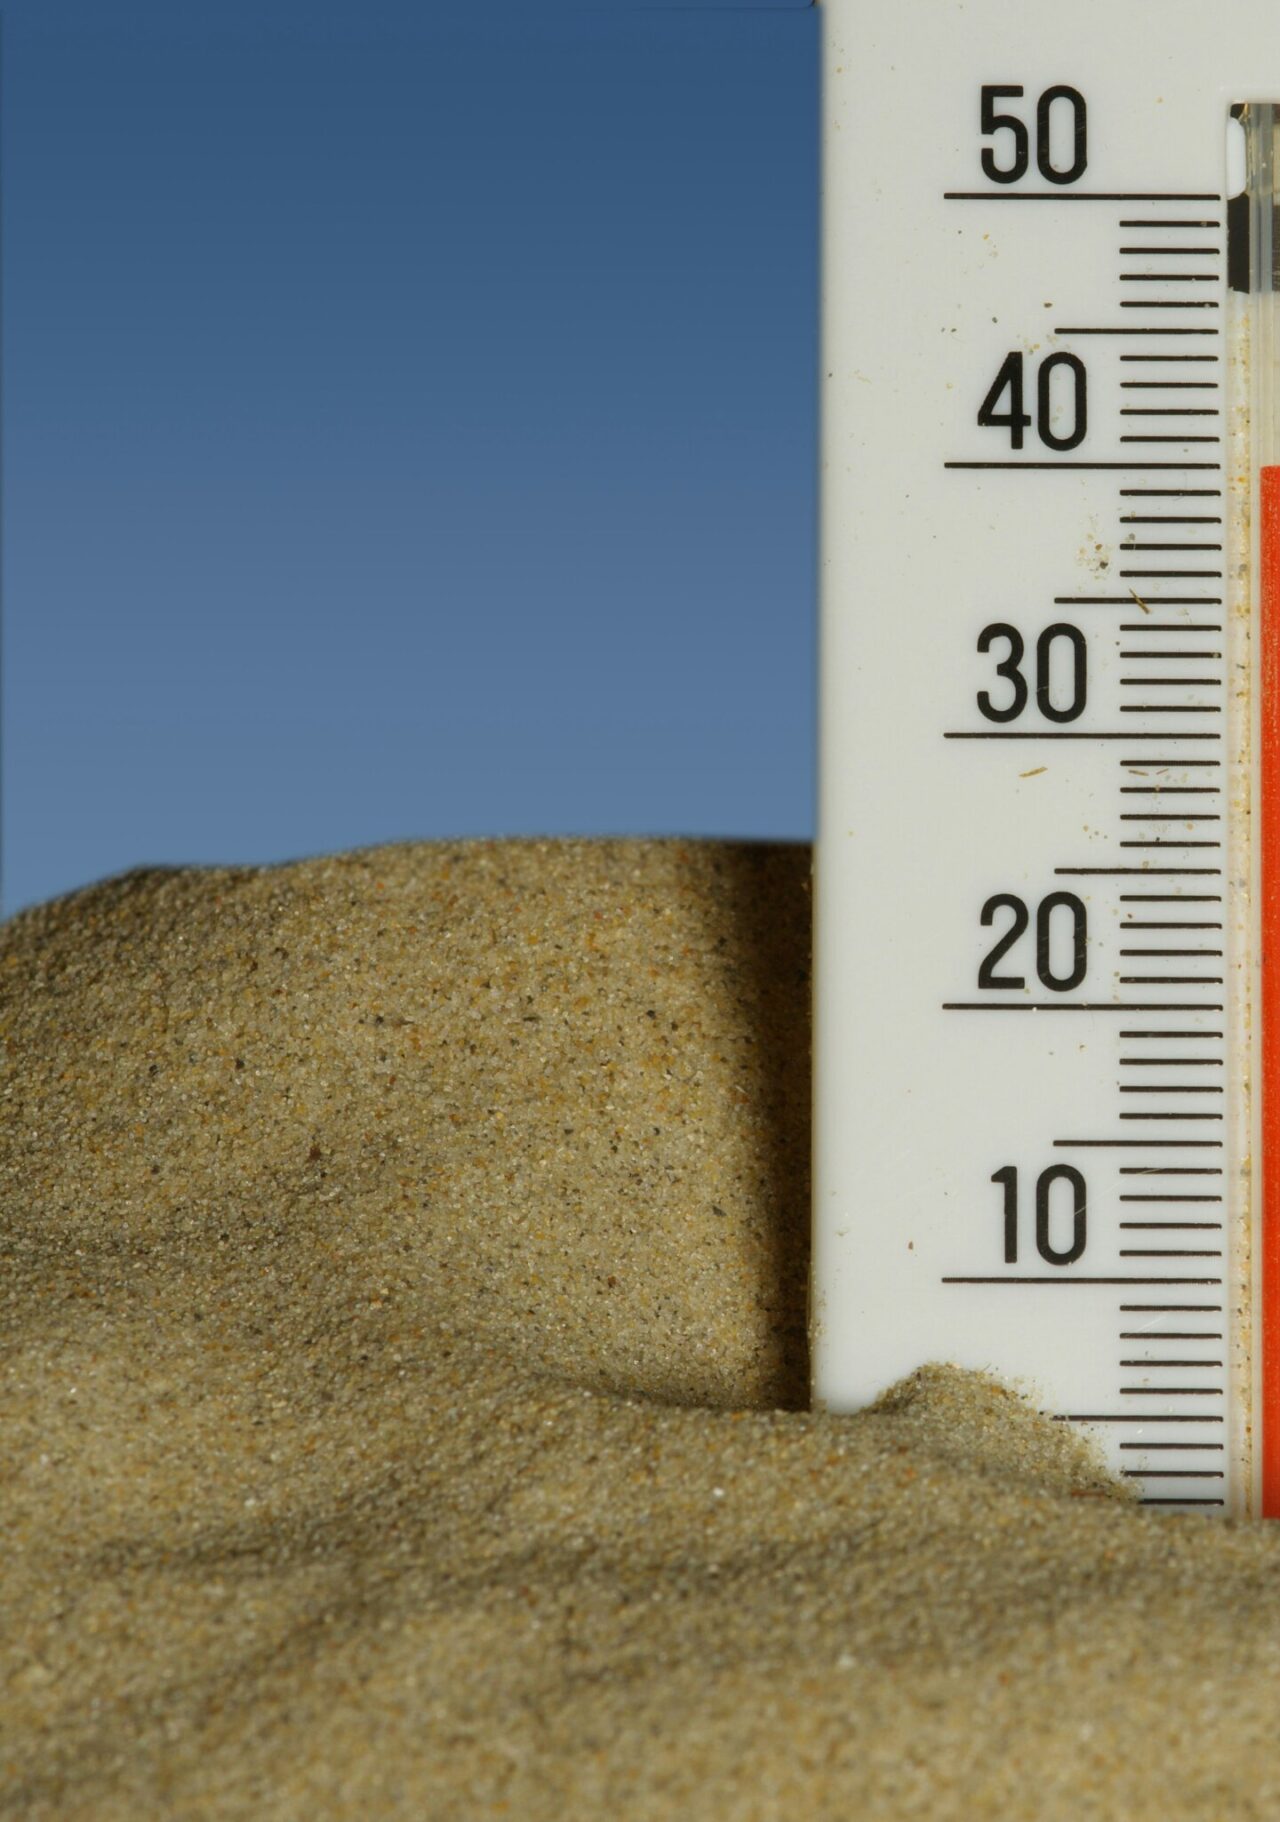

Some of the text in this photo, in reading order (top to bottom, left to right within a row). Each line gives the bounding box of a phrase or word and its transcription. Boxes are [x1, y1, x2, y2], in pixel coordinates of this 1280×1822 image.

[980, 84, 1088, 185] 50
[977, 351, 1088, 452] 40
[976, 622, 1088, 724] 30
[977, 891, 1088, 993] 20
[990, 1163, 1087, 1266] 10
